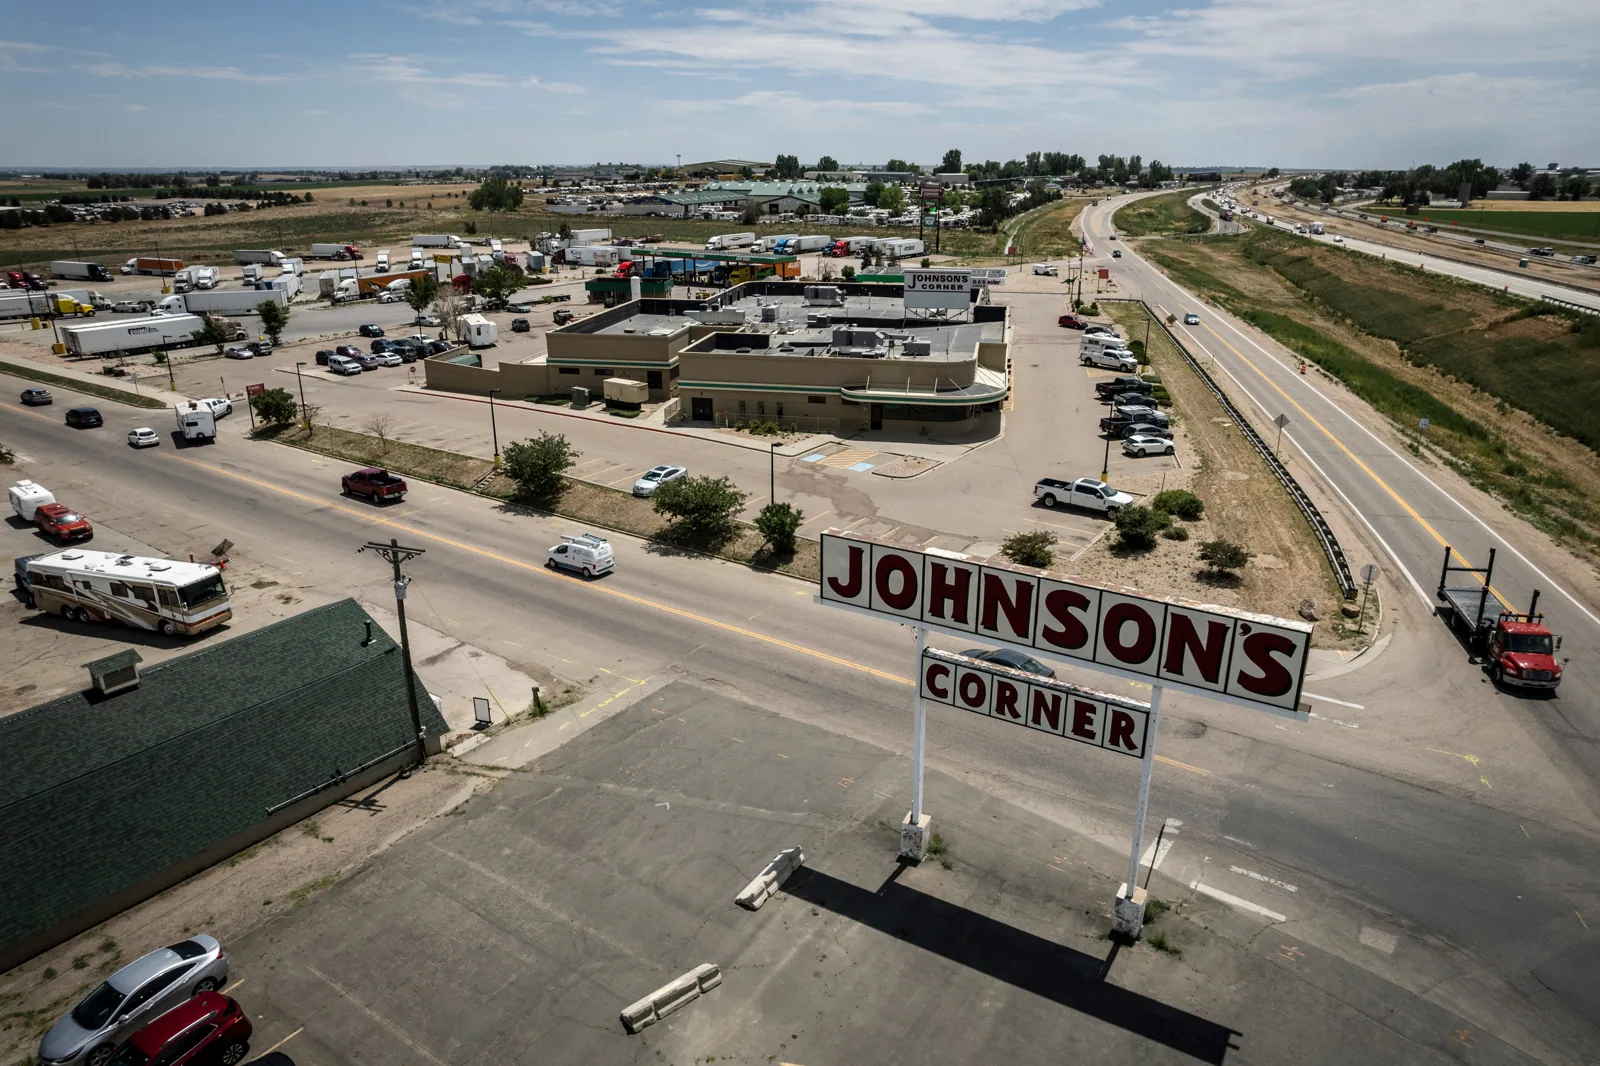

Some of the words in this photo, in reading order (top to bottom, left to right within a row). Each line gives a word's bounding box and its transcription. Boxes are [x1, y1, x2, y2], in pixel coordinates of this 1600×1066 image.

[908, 274, 968, 289] JOHNSON'S
[827, 545, 1297, 698] JOHNSON'S
[924, 662, 1138, 751] CORNER
